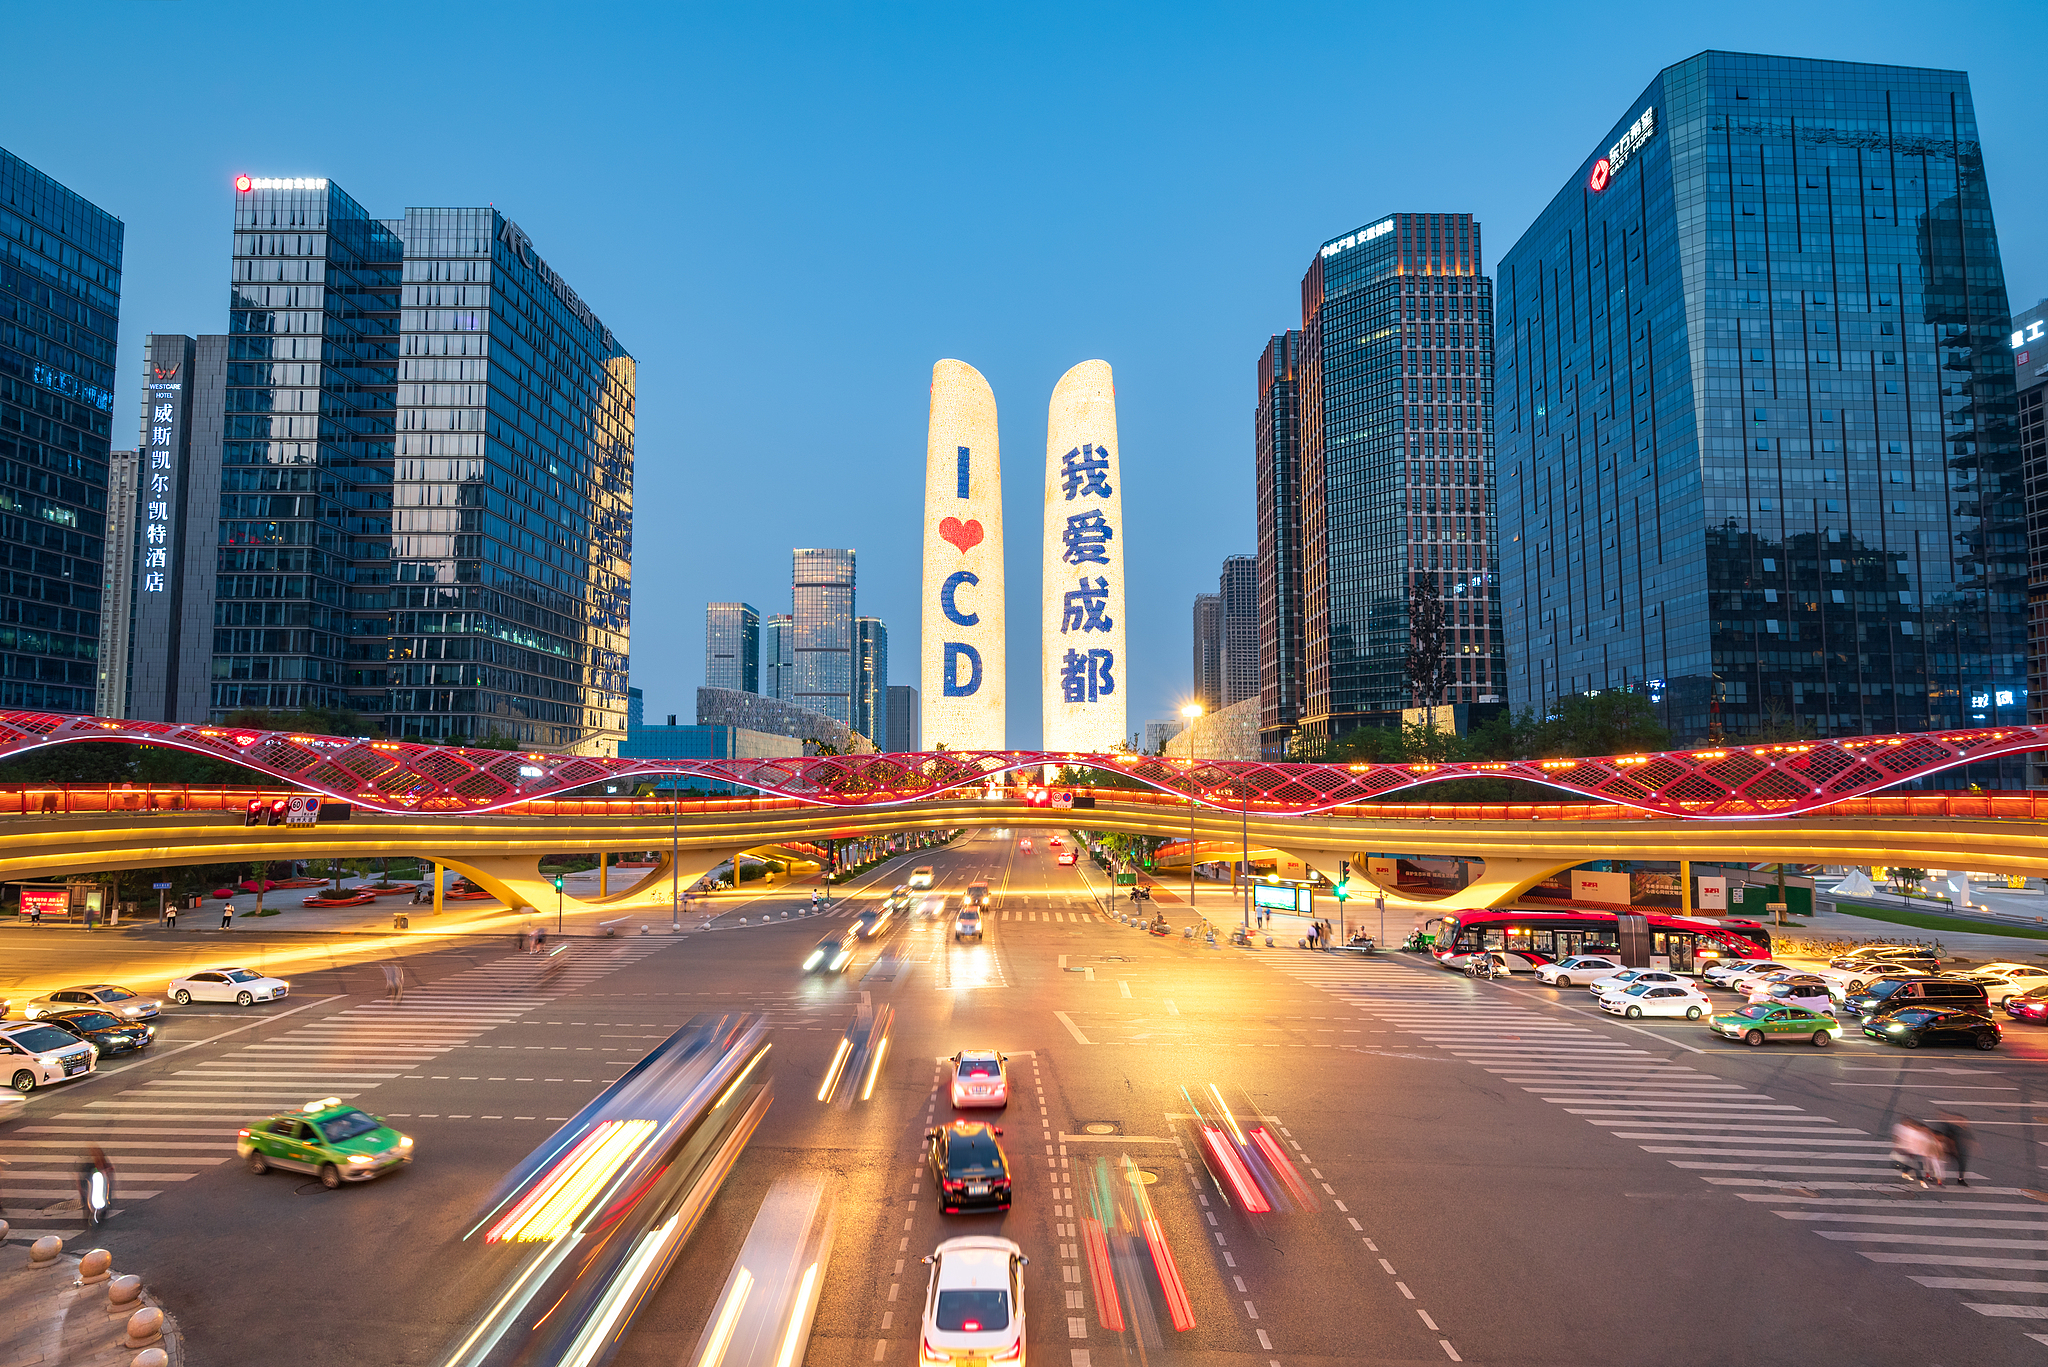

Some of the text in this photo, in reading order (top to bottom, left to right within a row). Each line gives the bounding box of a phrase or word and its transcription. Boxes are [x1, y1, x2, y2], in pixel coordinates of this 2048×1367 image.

[1609, 106, 1653, 165] 东方希望
[1610, 126, 1653, 176] EAST HOPE
[539, 255, 613, 351] 中航国际广场
[144, 403, 173, 592] 威斯凯尔·凯特酒店
[957, 446, 970, 500] I
[1061, 443, 1115, 703] 我爱成都
